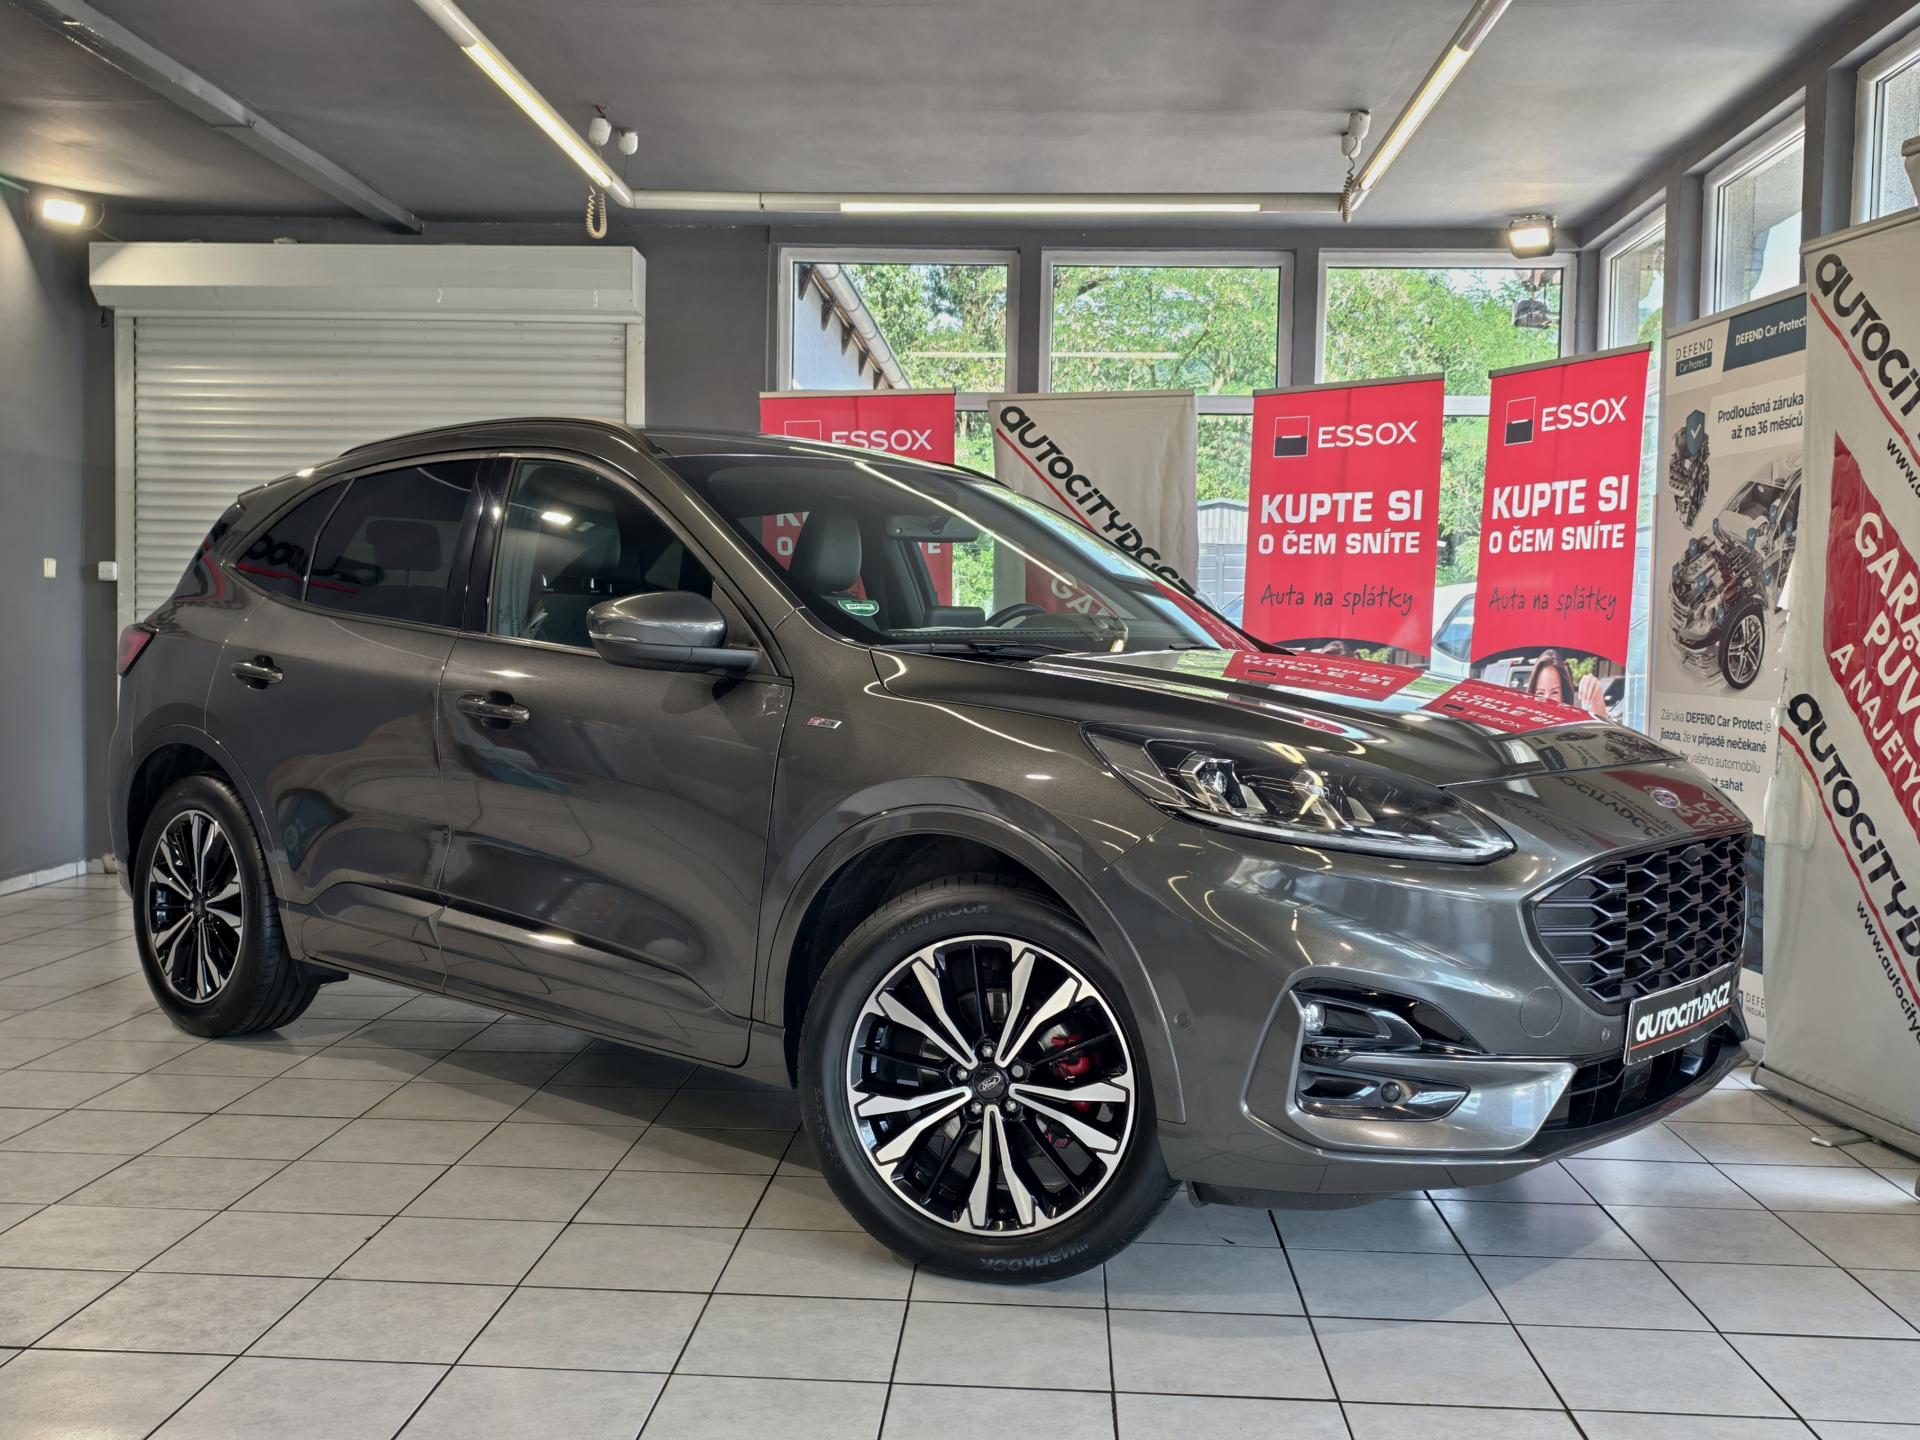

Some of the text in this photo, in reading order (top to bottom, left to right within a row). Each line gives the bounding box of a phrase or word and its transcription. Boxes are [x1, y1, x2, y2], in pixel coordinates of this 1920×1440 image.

[1735, 316, 1807, 346] DEFEND Car Protect
[1676, 338, 1713, 361] DEFEND
[1541, 396, 1628, 432] ESSOX
[1717, 391, 1804, 423] Prodloužená záruka
[832, 429, 933, 451] ESSOX
[1318, 421, 1418, 449] ESSOX
[1731, 410, 1804, 440] až na 36 měsíců
[1261, 489, 1423, 524] KUPTE SI
[1492, 474, 1630, 520] KUPTE SI
[1258, 527, 1421, 555] O ČEM SNÍTE
[1488, 519, 1626, 554] O ČEM SNÍTE
[1260, 583, 1414, 616] Auta na splátky
[1488, 585, 1617, 621] Auta na splátky
[1831, 643, 1855, 675] A
[1863, 611, 1920, 746] PŮV
[1661, 708, 1772, 735] Záruka DEFEND Car Protect je
[1660, 727, 1767, 754] jistota, že v případě nečekané
[1690, 750, 1715, 767] vašeho
[1715, 757, 1761, 775] automobilu
[1720, 778, 1744, 792] sahat
[1745, 992, 1766, 1009] DEFE
[1745, 1005, 1766, 1019] INSURA
